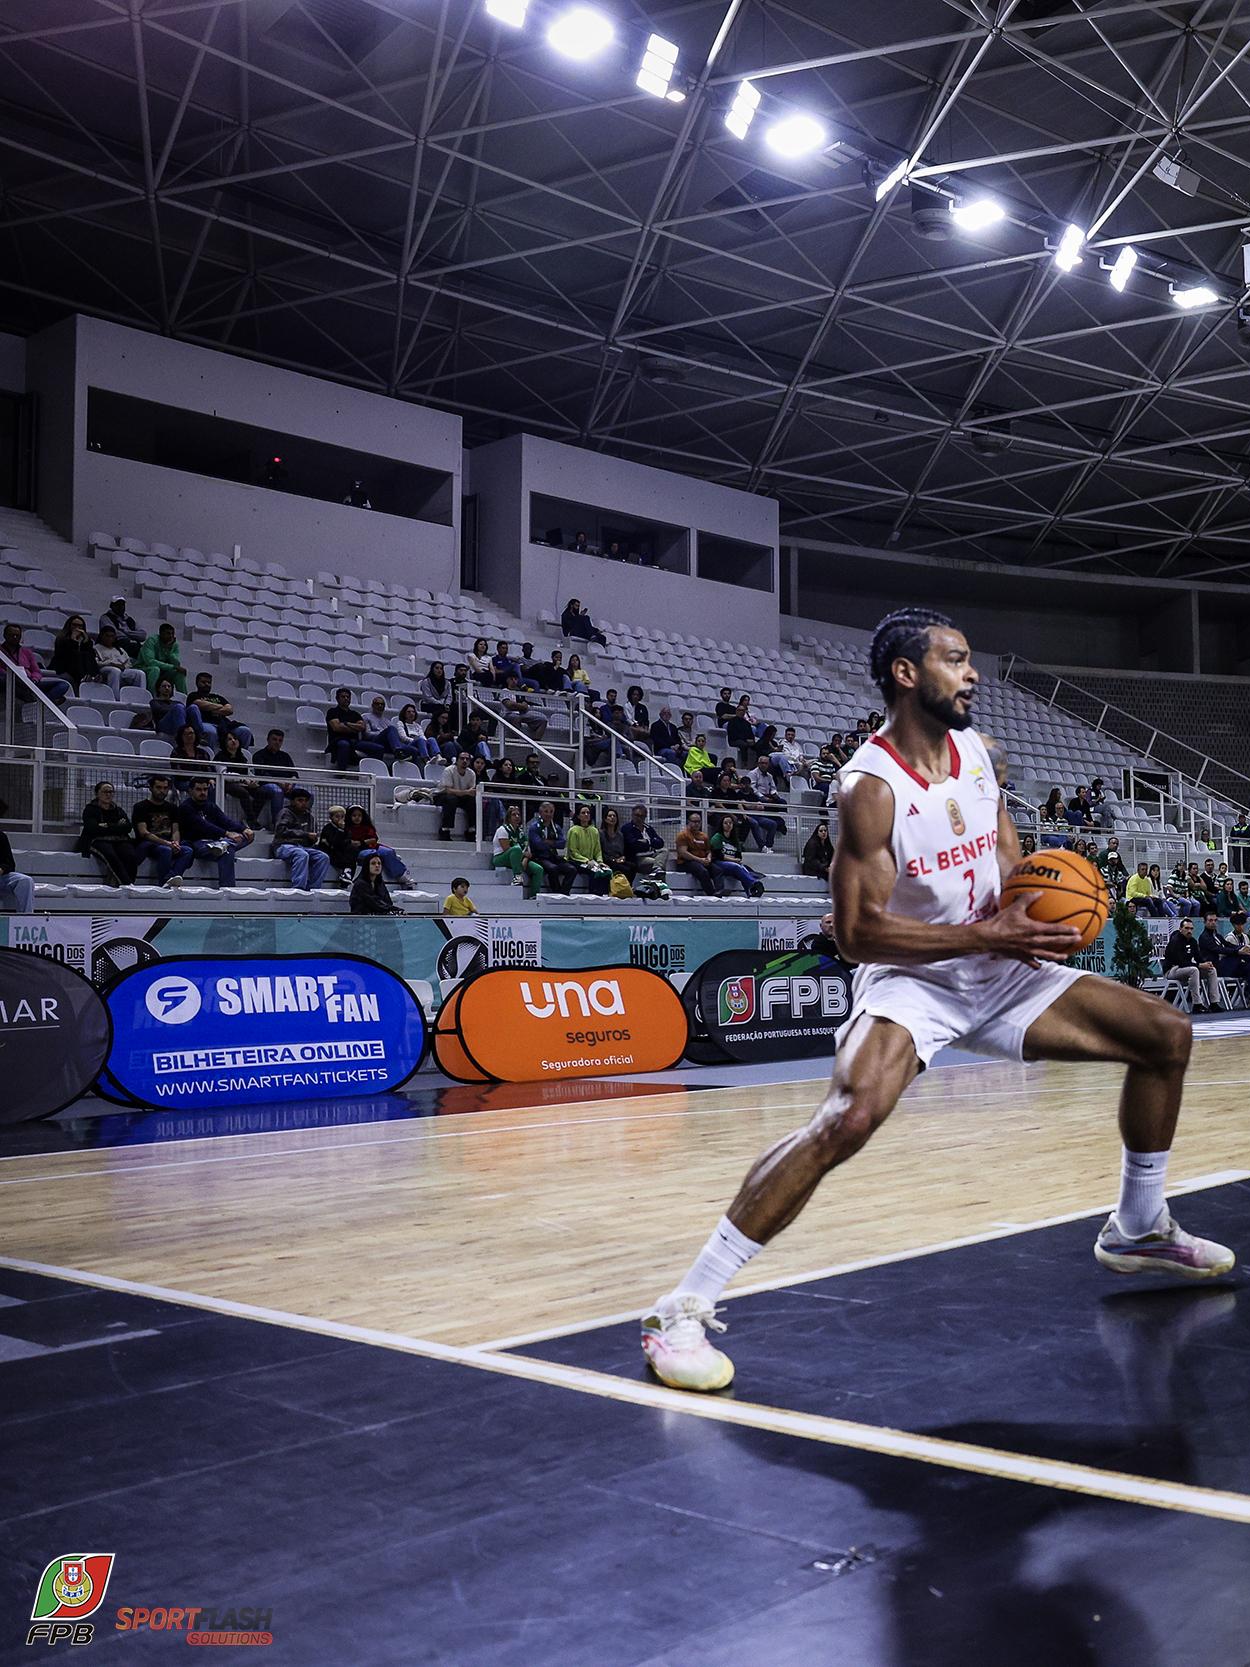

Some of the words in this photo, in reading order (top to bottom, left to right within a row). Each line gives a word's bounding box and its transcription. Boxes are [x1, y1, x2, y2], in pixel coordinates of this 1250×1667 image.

[906, 856, 933, 878] SL
[14, 926, 48, 944] TAÇA
[491, 926, 513, 940] TAÇA
[628, 925, 655, 944] TAÇA
[761, 927, 777, 938] TAÇA
[66, 948, 85, 959] DOS
[492, 941, 524, 959] HUGO
[525, 944, 537, 954] DOS
[629, 944, 669, 968] HUGO
[671, 948, 685, 961] DOS
[325, 993, 381, 1023] FAN
[520, 979, 626, 1018] una
[760, 976, 849, 1021] FPB
[566, 1028, 631, 1047] seguros
[725, 1031, 763, 1043] FEDERAÇÃO
[763, 1029, 802, 1040] PORTUGUESA
[803, 1028, 811, 1036] DE
[156, 1048, 296, 1071] BILHETEIRA
[300, 1042, 383, 1061] ONLINE
[541, 1058, 601, 1071] Seguradora
[603, 1054, 634, 1066] oficial
[155, 1068, 388, 1097] WWW.SMARTFAN.TICKETS
